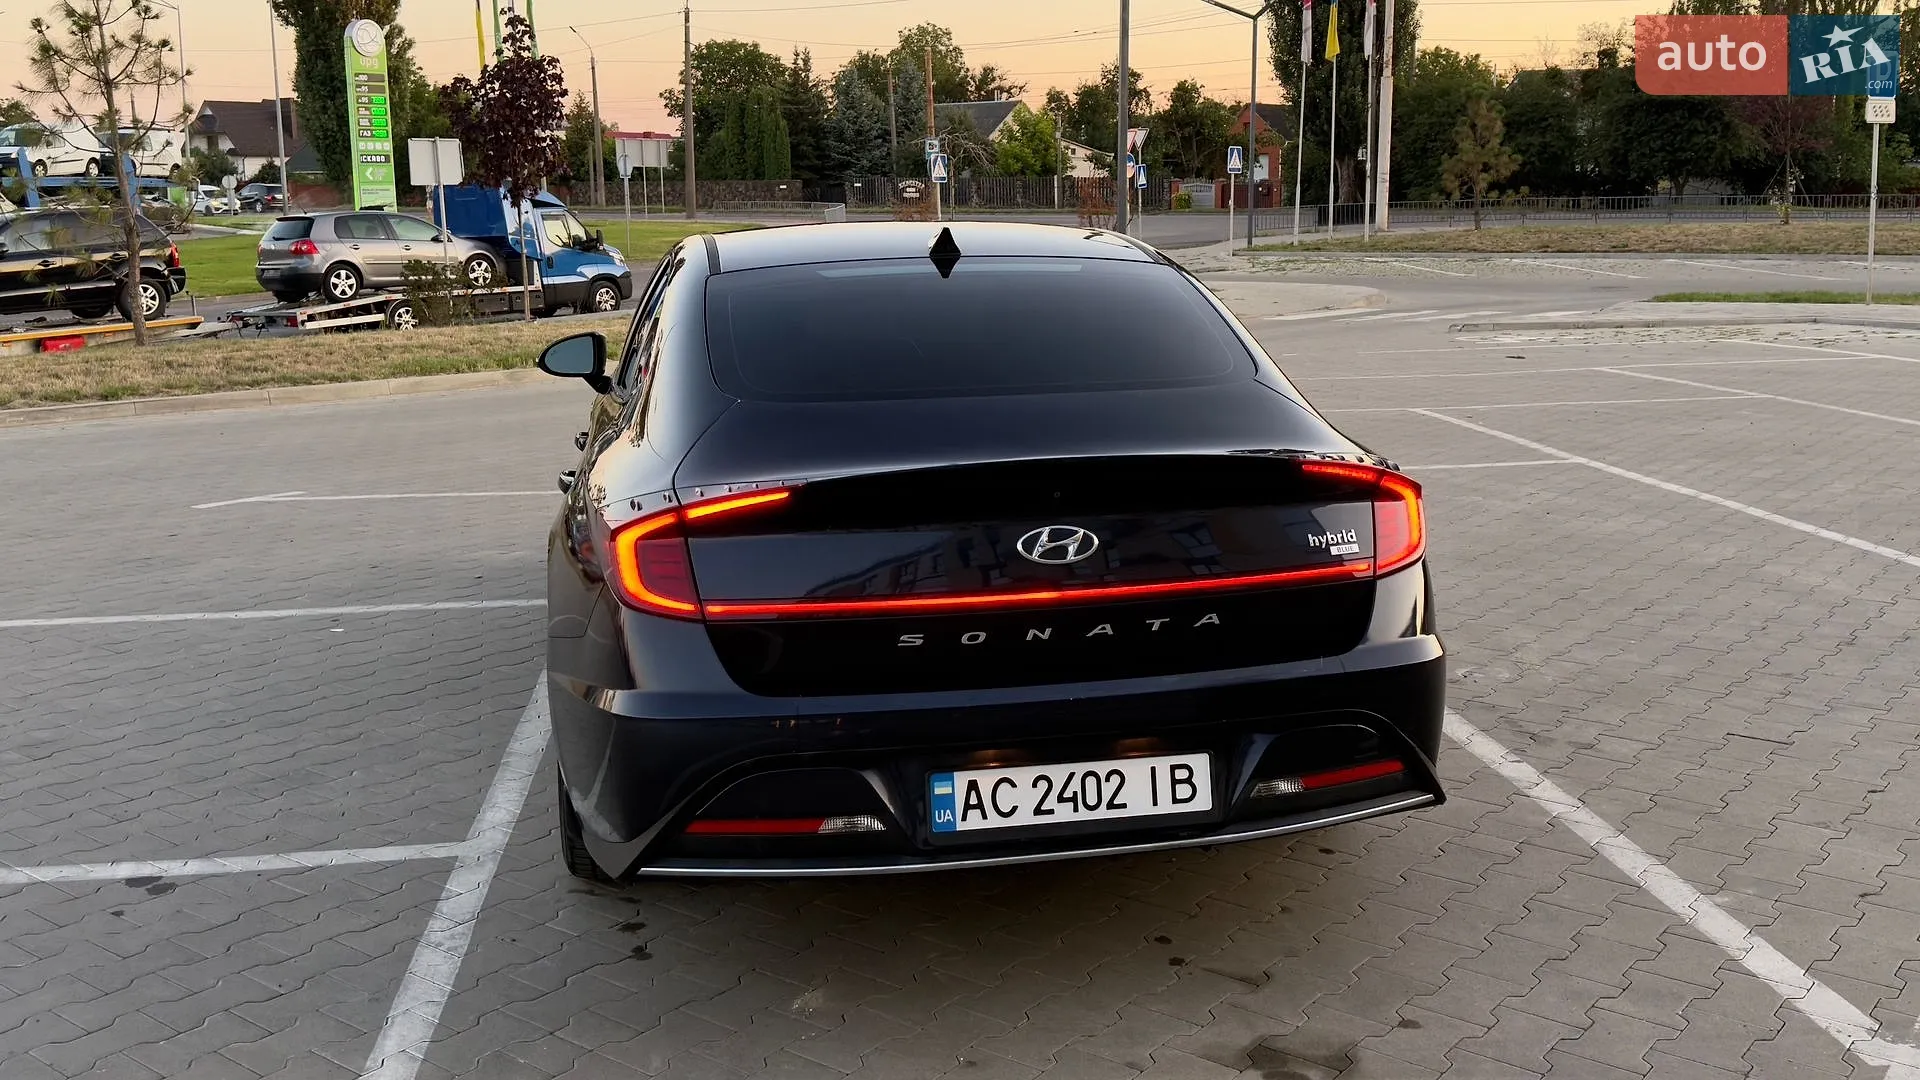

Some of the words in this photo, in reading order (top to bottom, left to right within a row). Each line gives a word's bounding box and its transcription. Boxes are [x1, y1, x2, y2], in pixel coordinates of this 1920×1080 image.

[1307, 529, 1357, 549] hybrid
[897, 613, 1221, 647] SONATA
[960, 776, 1019, 822] AC
[1031, 768, 1128, 816] 2402
[1149, 763, 1198, 807] IB
[935, 809, 953, 822] UA
